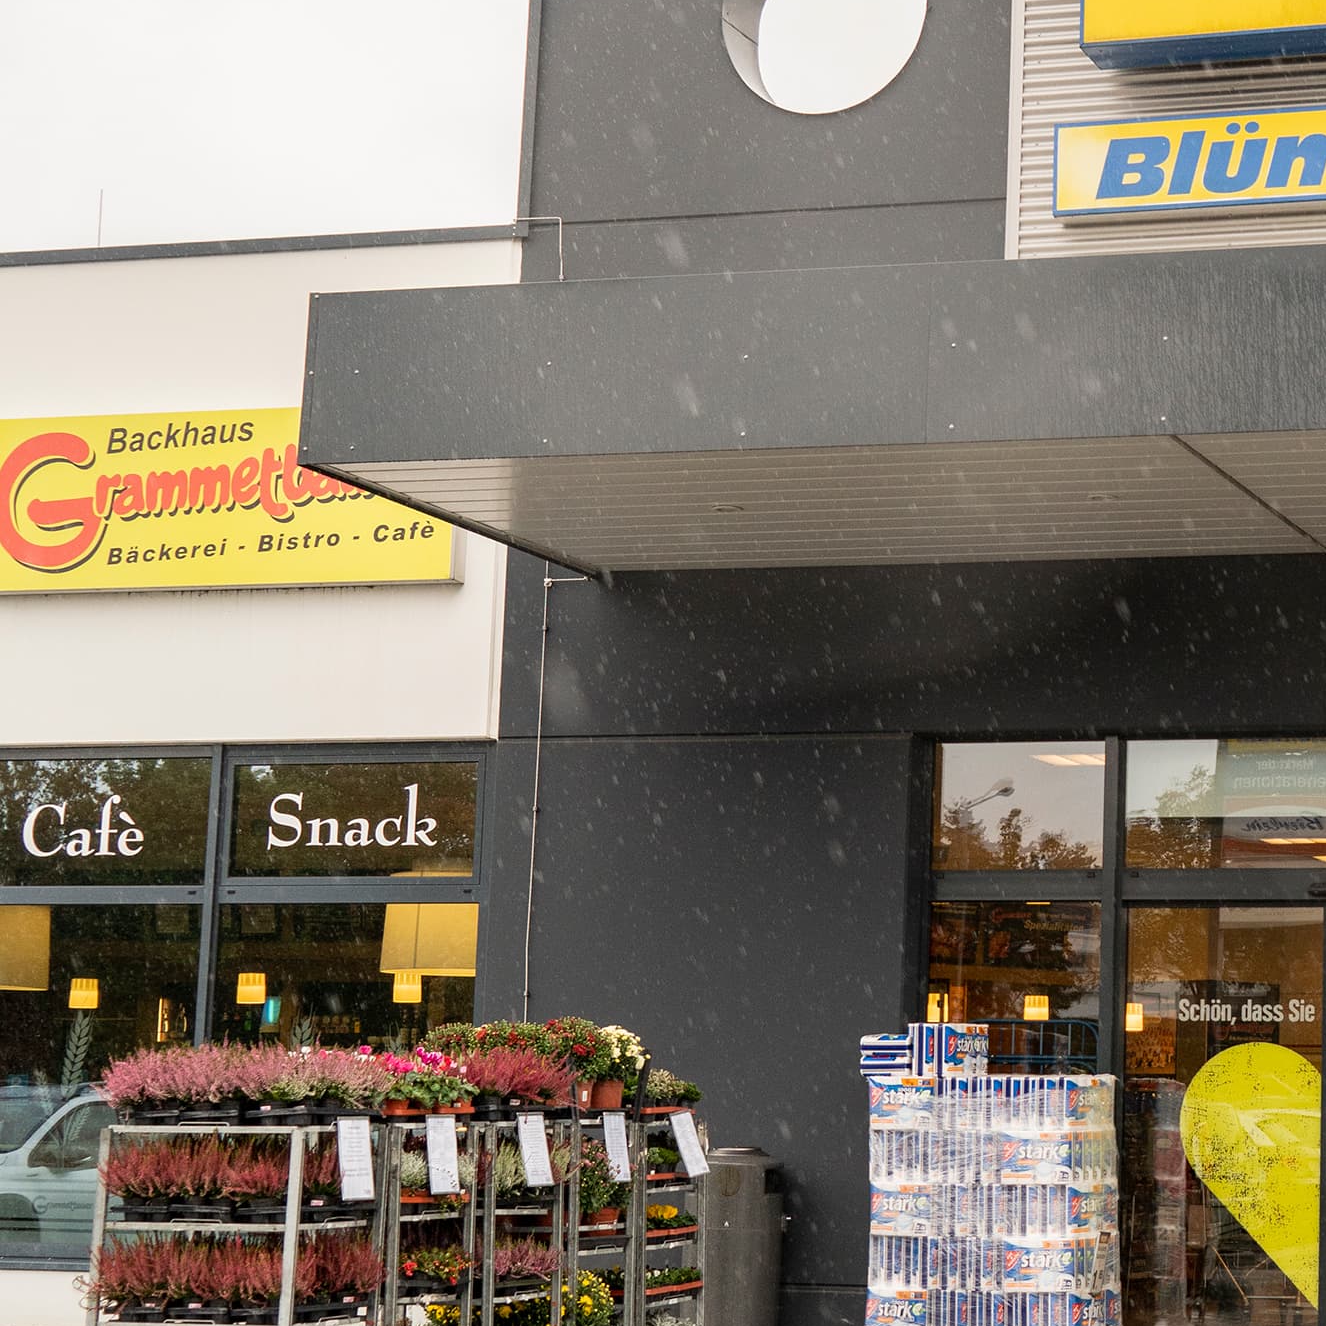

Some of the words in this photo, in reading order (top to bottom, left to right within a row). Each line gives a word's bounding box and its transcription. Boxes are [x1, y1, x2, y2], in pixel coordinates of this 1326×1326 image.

[106, 421, 255, 455] Backhaus
[106, 538, 227, 566] Bäckerei
[257, 532, 341, 553] Bistro
[372, 520, 435, 543] Cafè
[22, 794, 145, 857] Cafè
[266, 783, 438, 851] Snack
[1178, 998, 1236, 1026] Schön,
[1241, 998, 1285, 1023] dass
[1288, 998, 1316, 1023] Sie
[878, 1301, 914, 1318] stark
